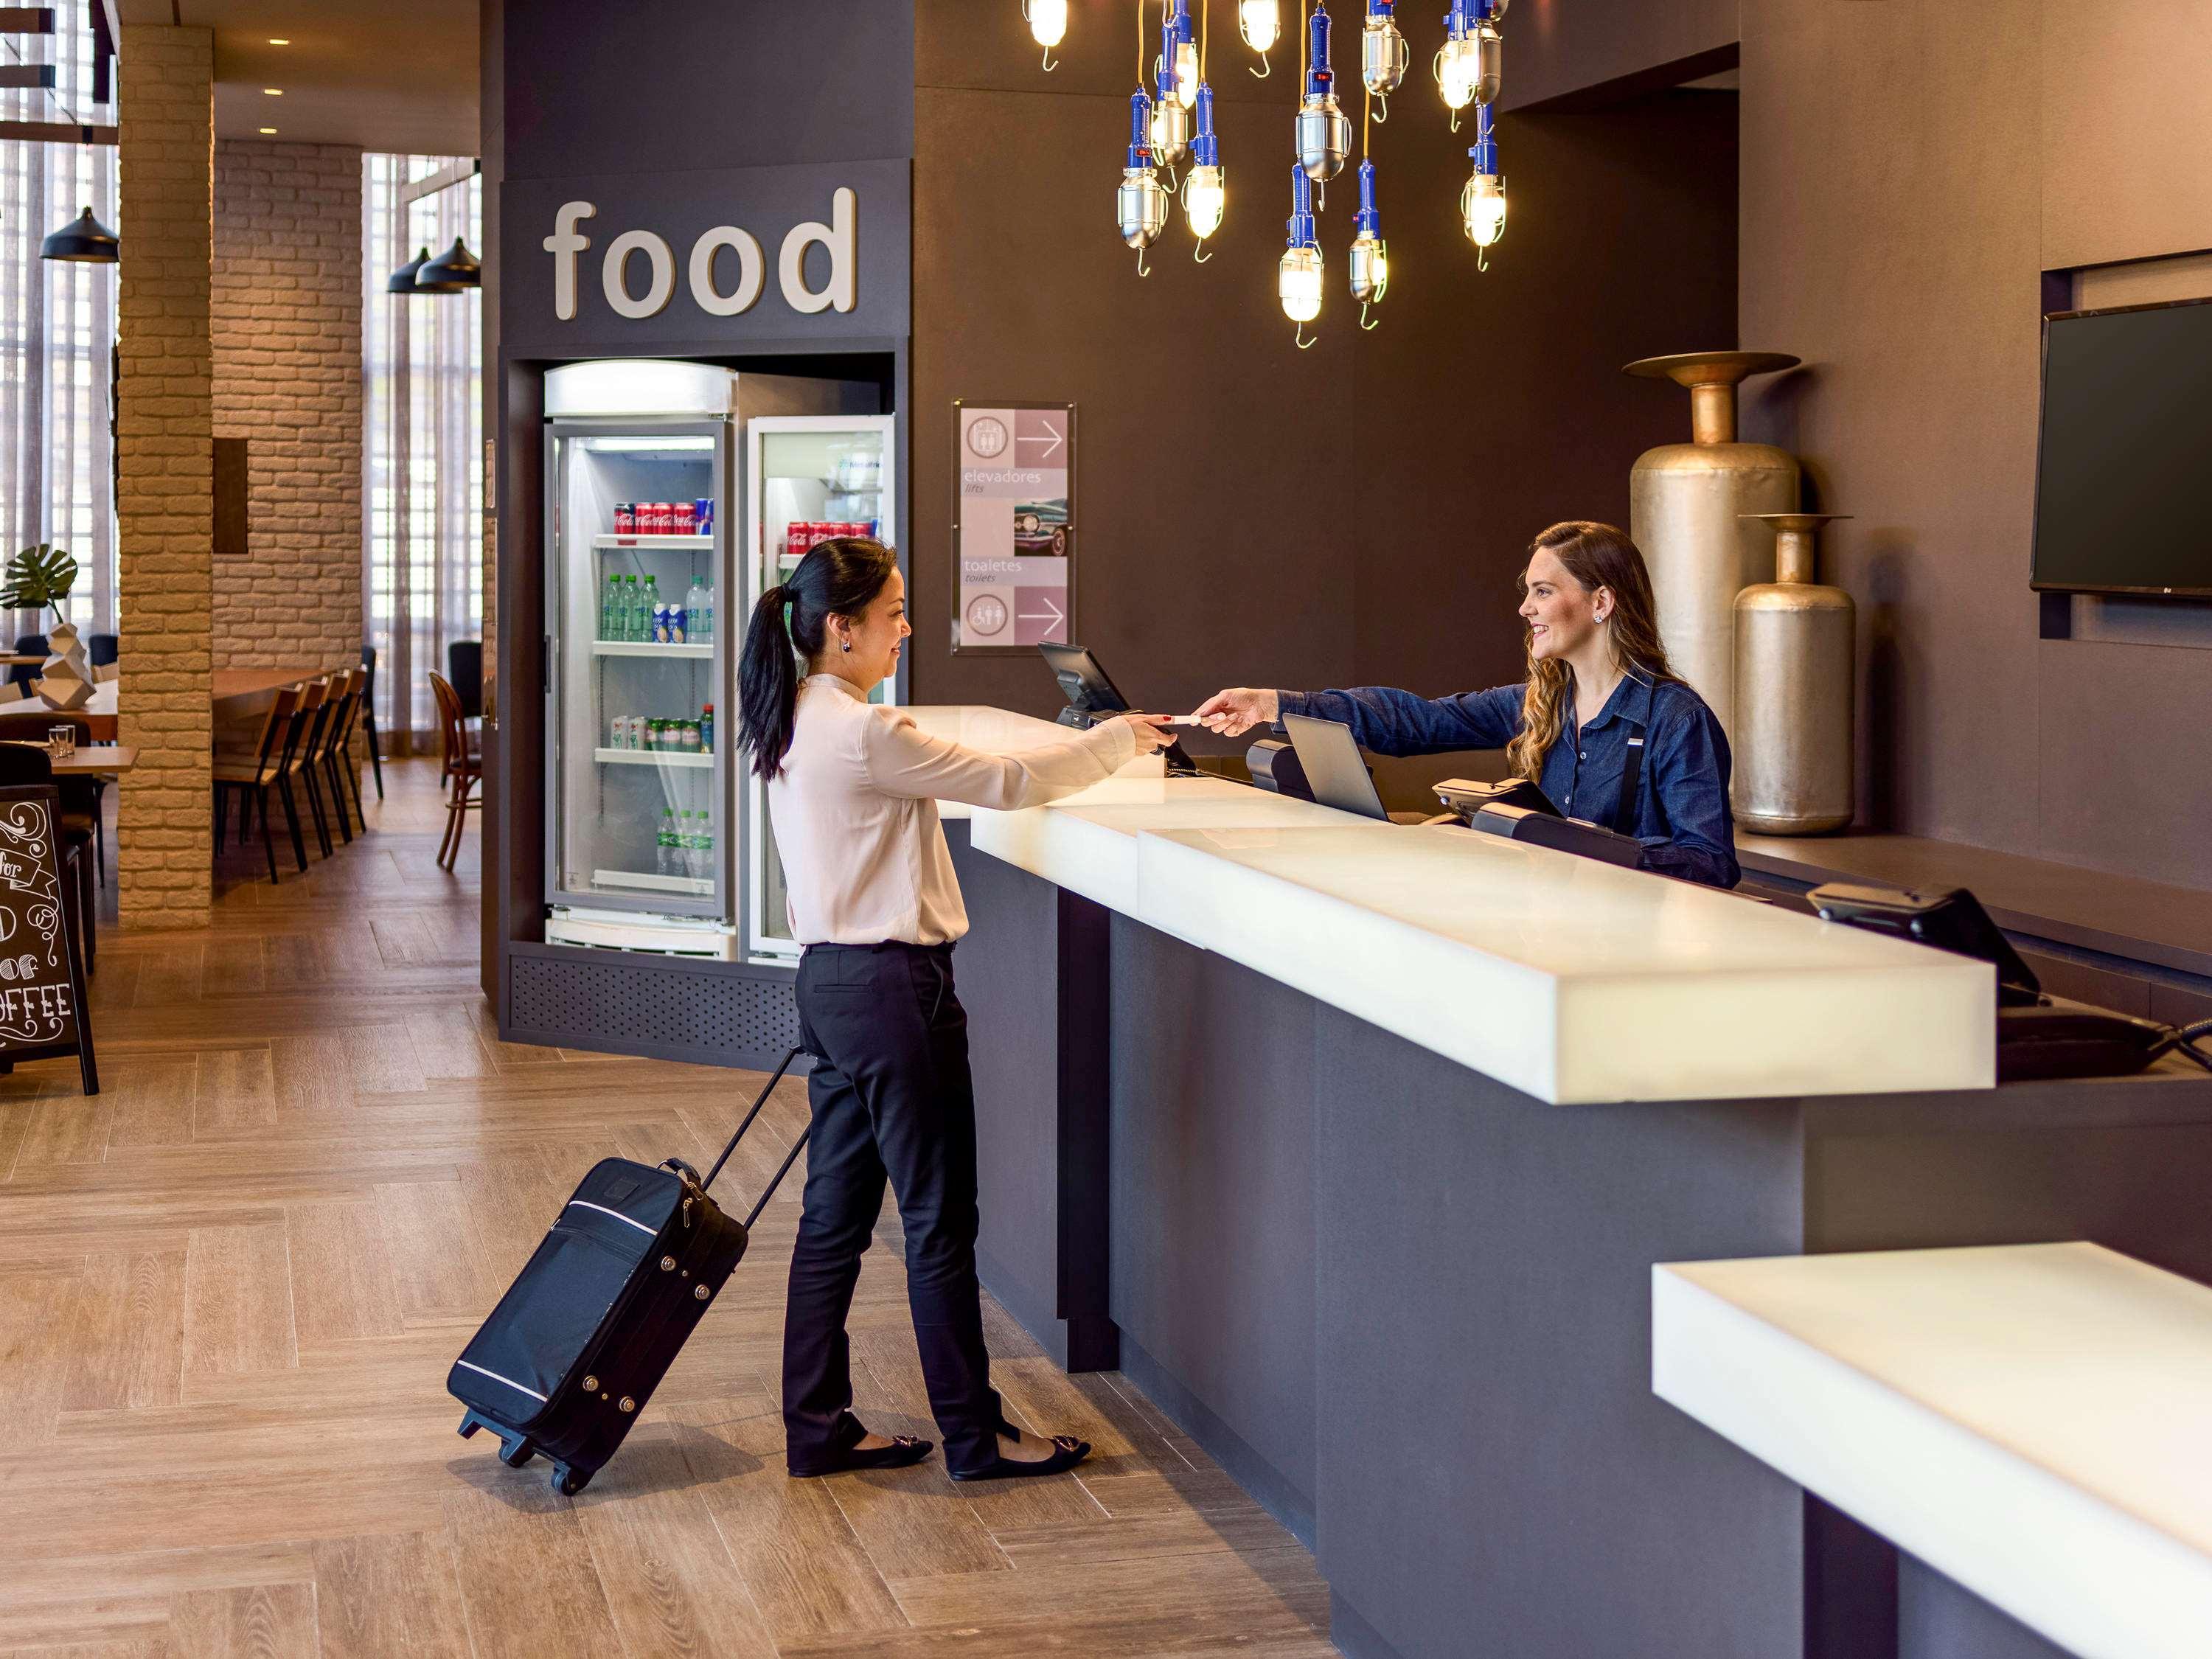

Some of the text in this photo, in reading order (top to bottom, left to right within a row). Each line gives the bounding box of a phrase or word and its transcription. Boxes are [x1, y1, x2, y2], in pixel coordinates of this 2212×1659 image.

[543, 187, 857, 321] food
[964, 469, 1041, 483] elevadores
[965, 484, 984, 493] lifts
[965, 559, 1022, 572] toaletes
[965, 574, 996, 583] toilets
[0, 983, 71, 1022] FFEE
